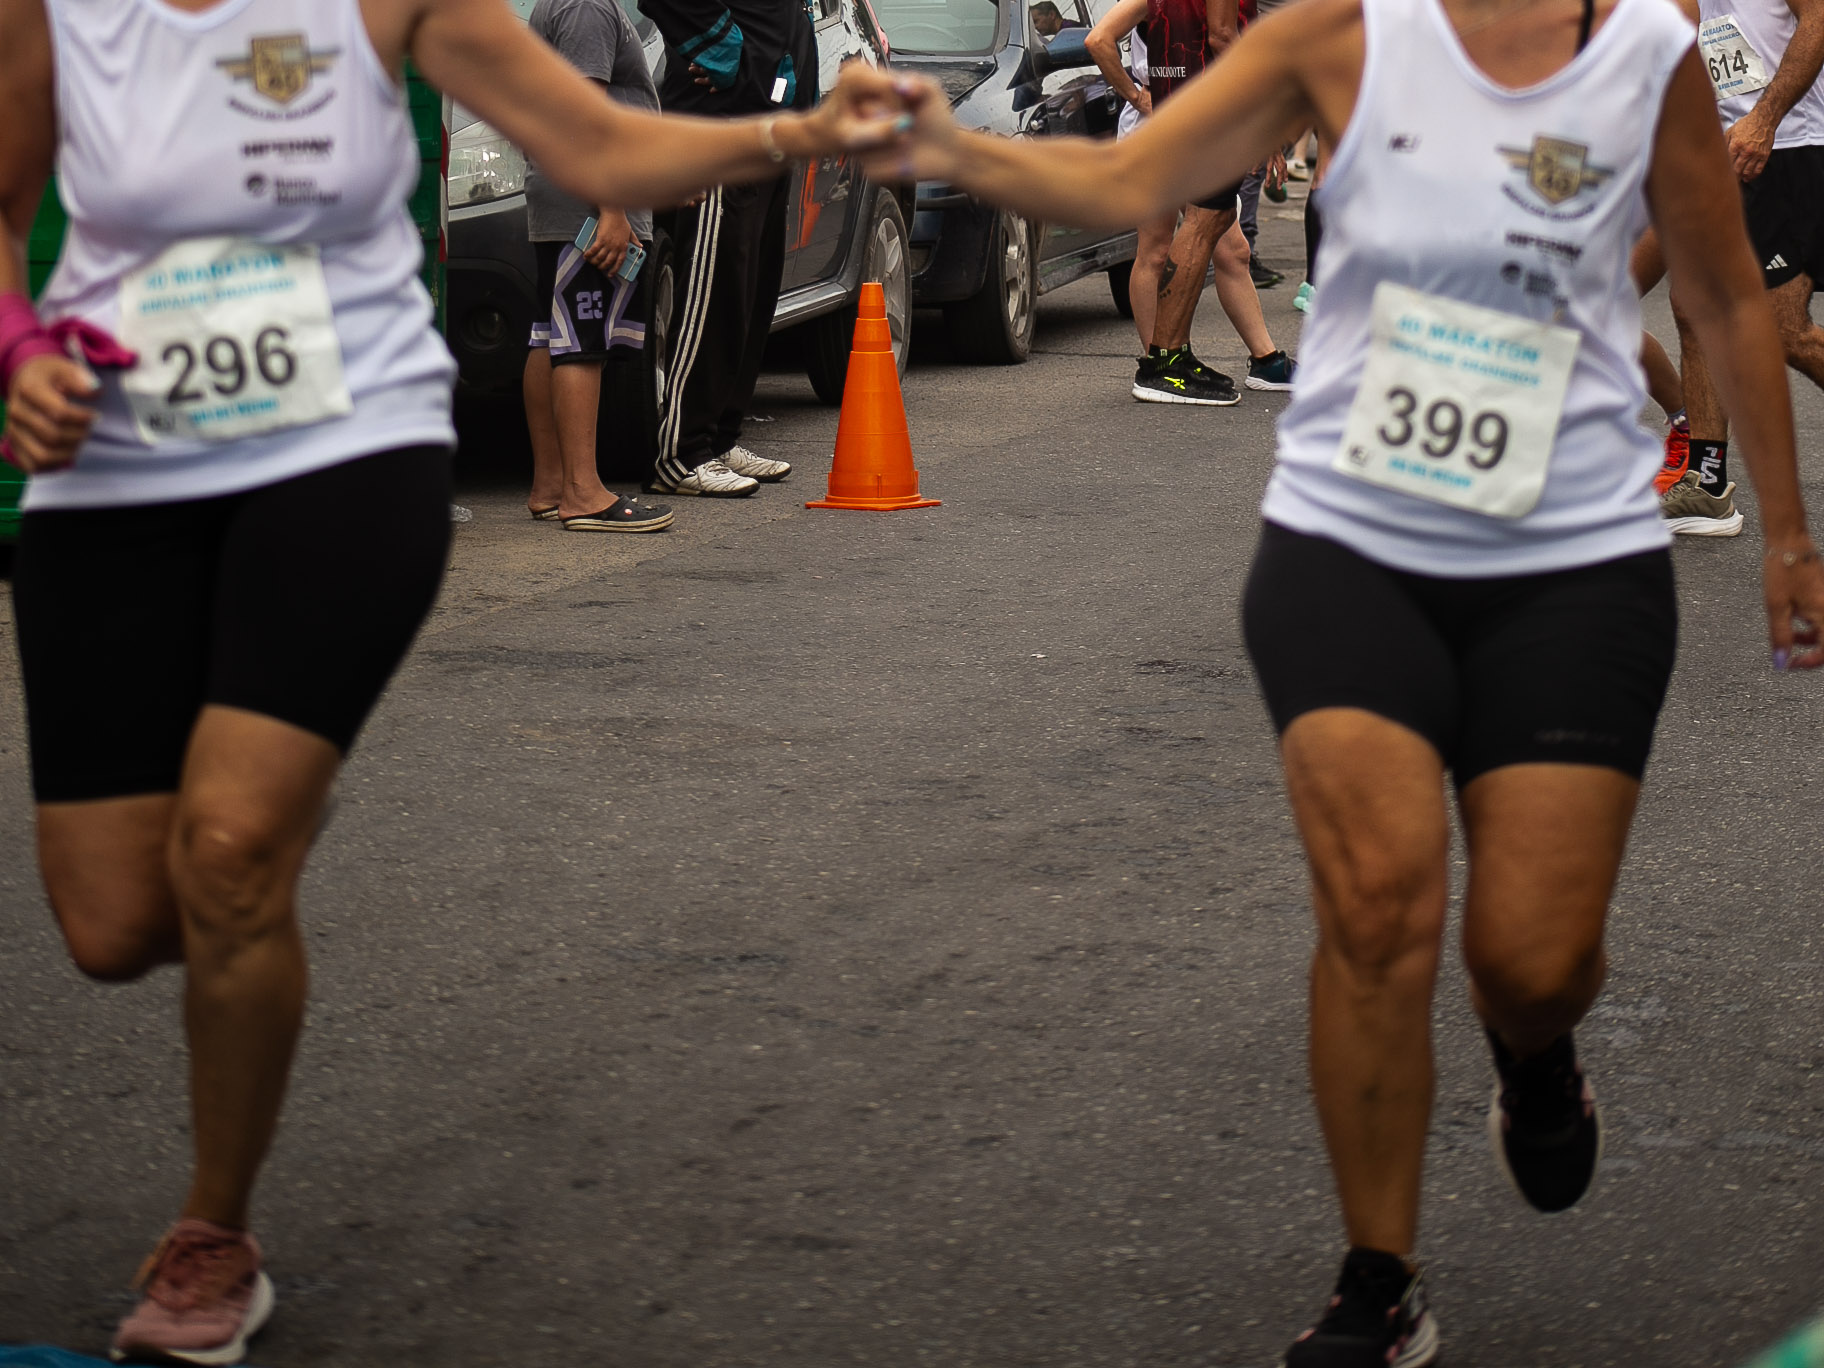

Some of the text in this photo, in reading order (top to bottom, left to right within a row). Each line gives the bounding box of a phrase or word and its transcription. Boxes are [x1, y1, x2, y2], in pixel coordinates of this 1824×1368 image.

[1708, 49, 1749, 83] 614
[576, 290, 603, 320] 23
[162, 326, 297, 404] 296
[1377, 386, 1509, 471] 399
[1700, 446, 1722, 484] FILA
